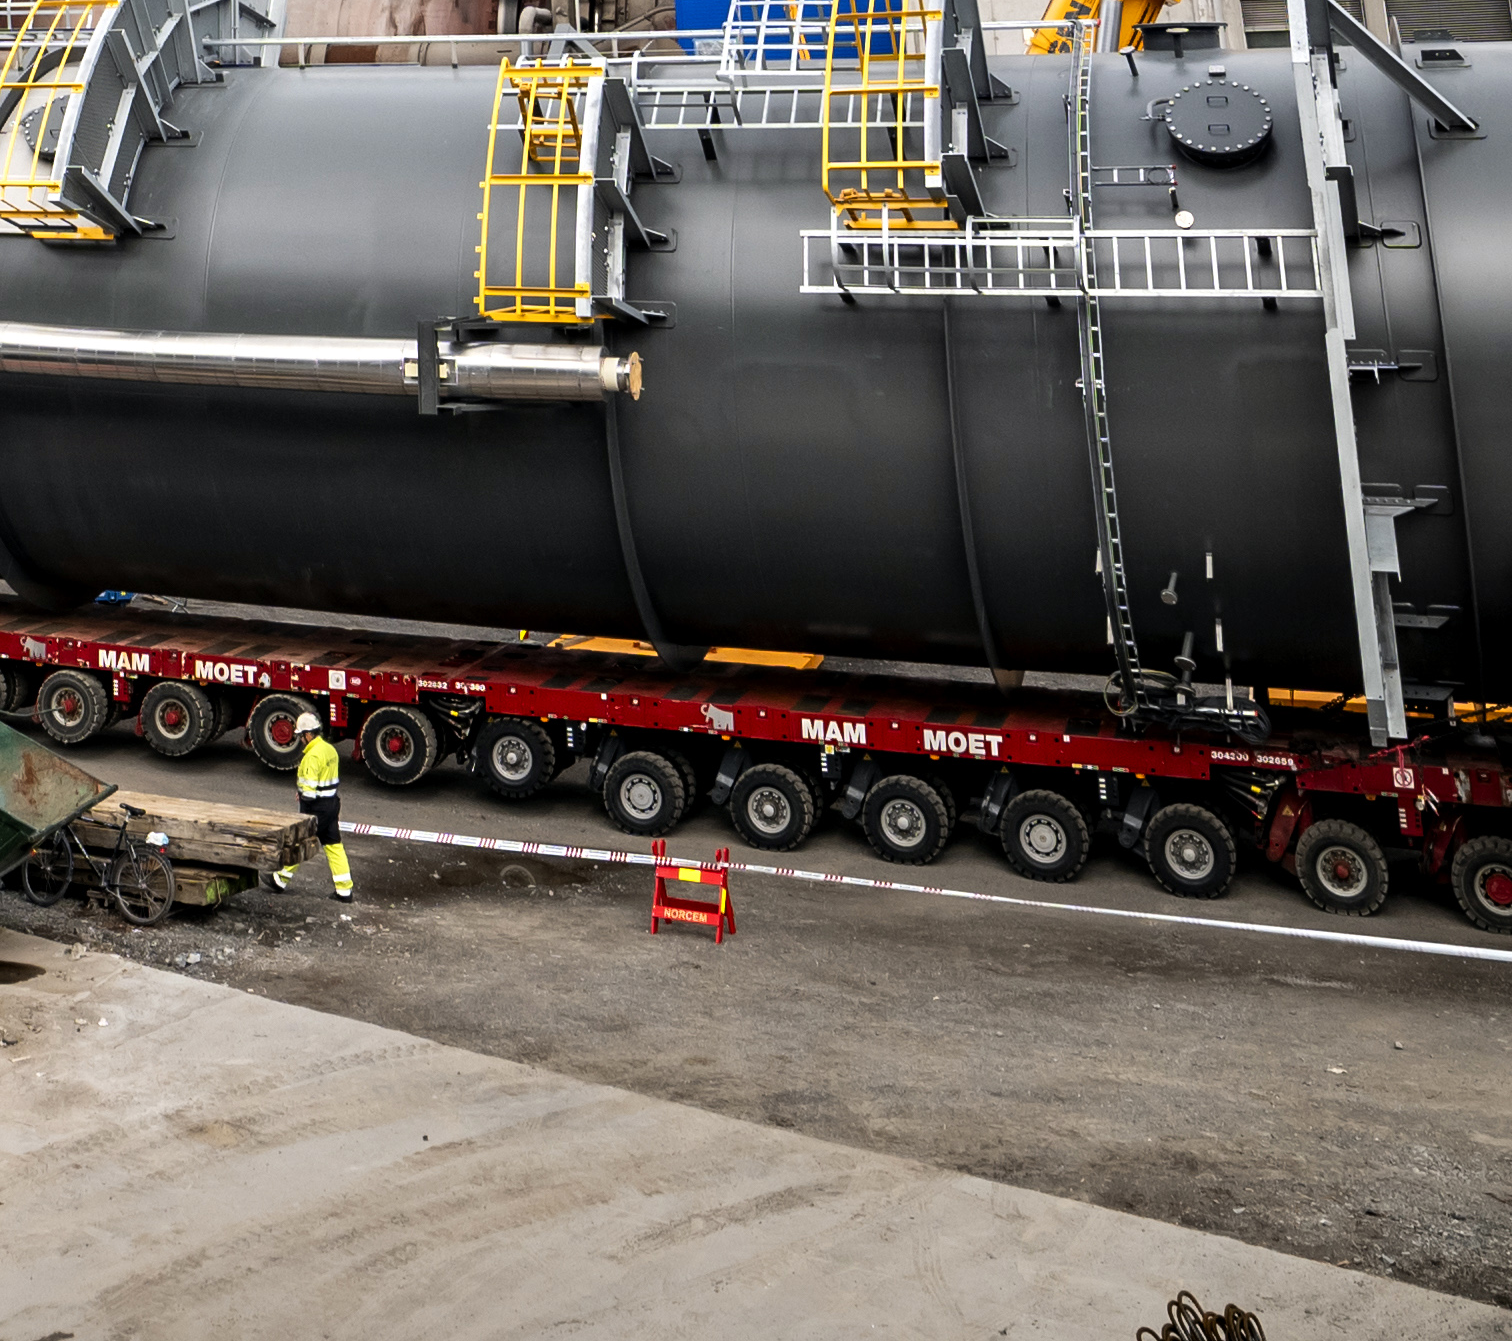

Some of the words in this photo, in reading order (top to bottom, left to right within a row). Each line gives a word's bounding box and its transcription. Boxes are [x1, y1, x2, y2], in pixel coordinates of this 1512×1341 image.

[97, 649, 150, 673] MAM
[194, 660, 257, 685] MOET
[801, 717, 867, 745] MAM
[922, 728, 1003, 757] MOET
[663, 908, 708, 923] NORCEM
